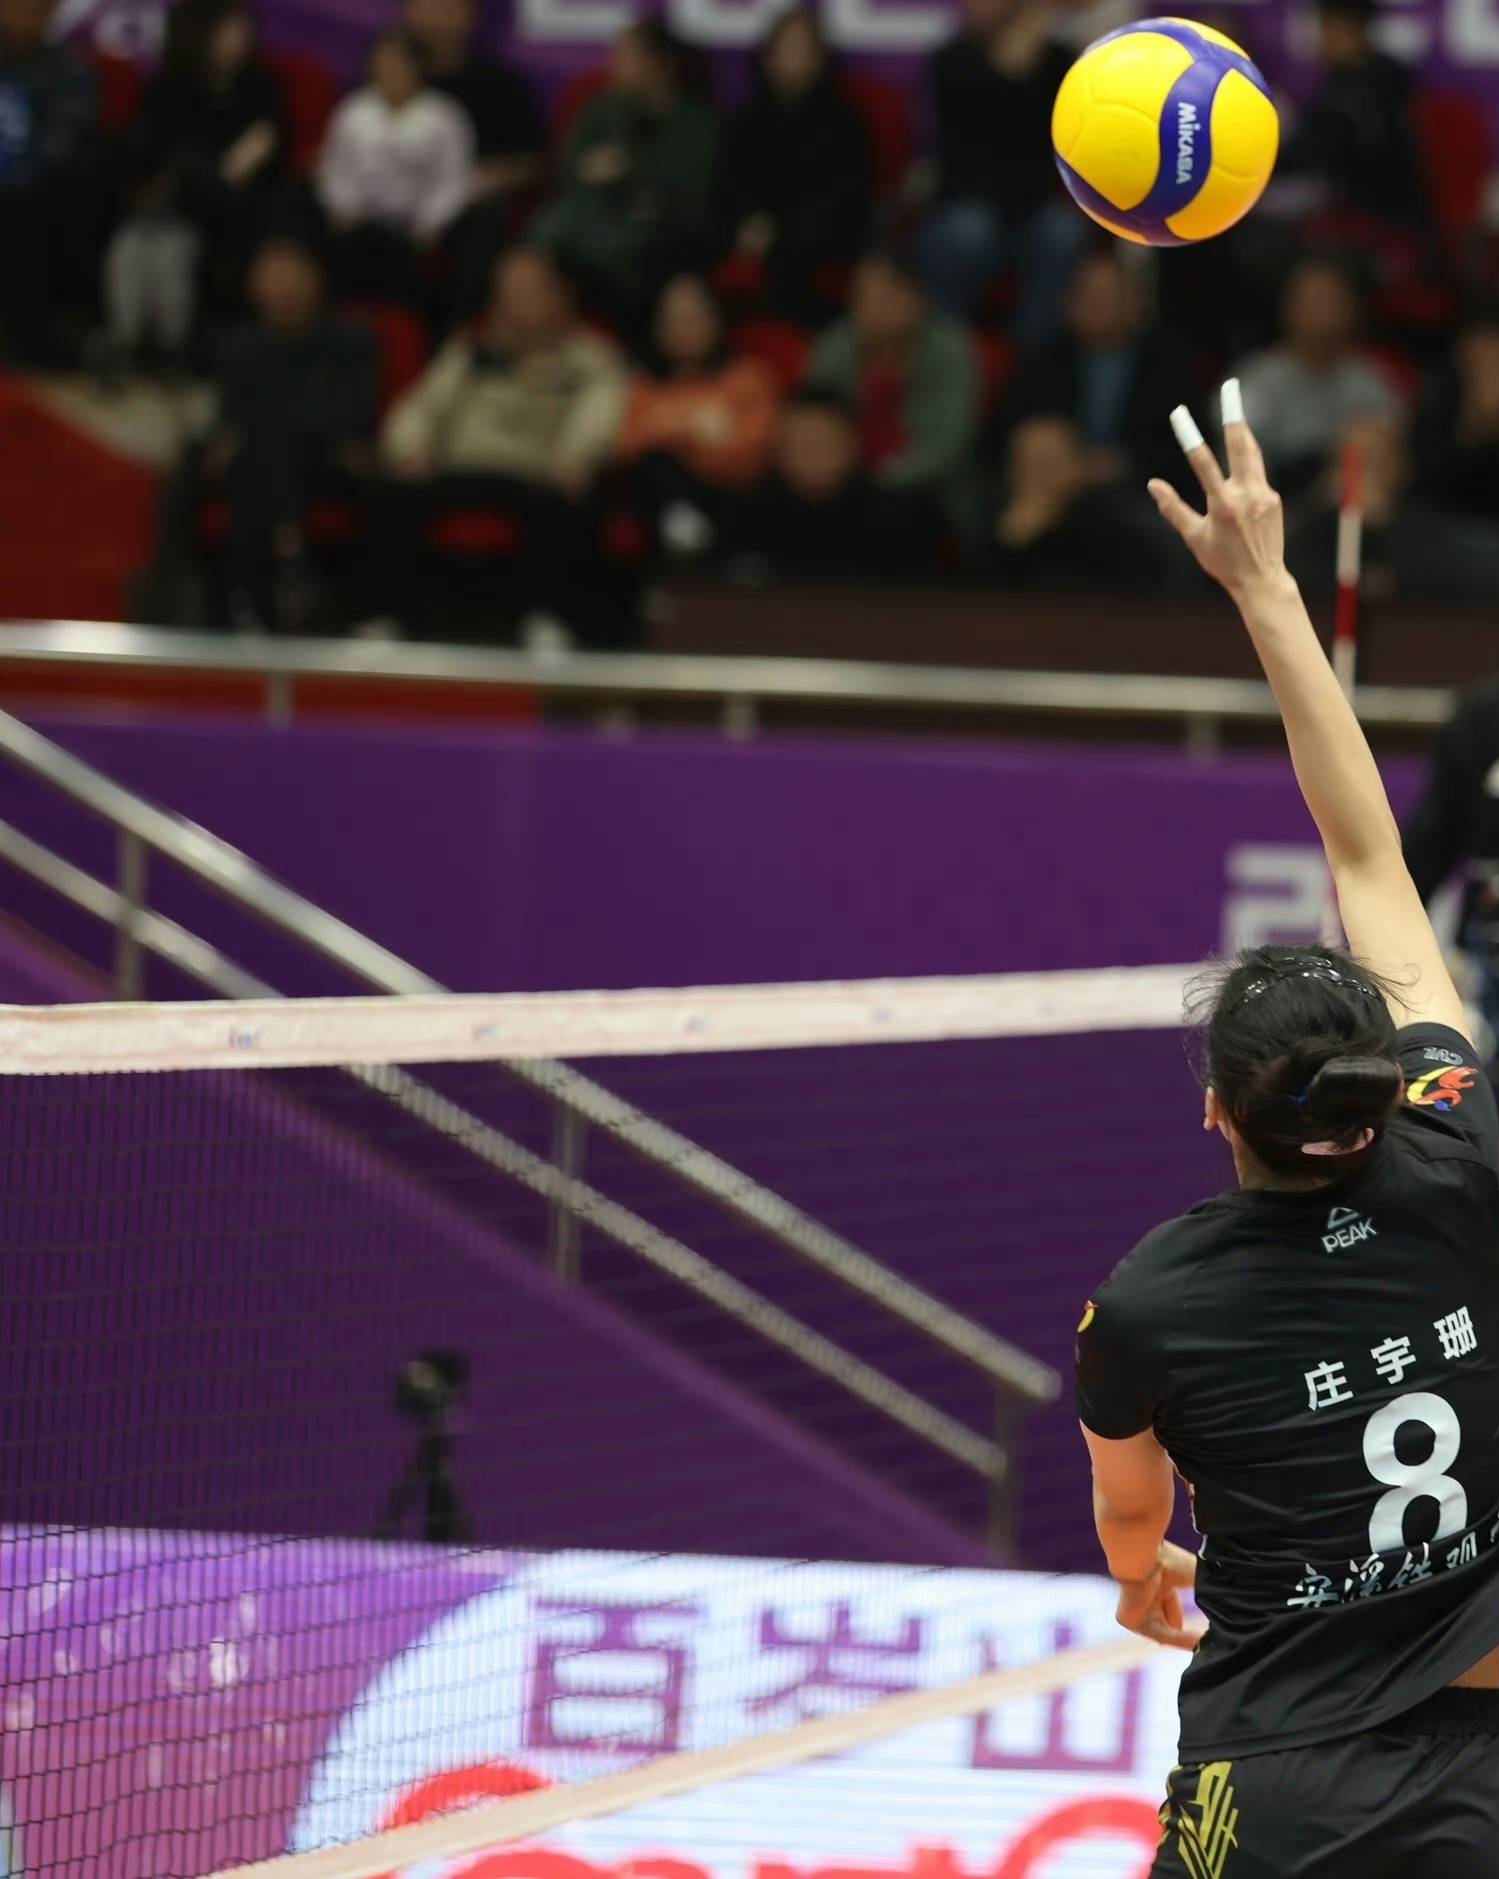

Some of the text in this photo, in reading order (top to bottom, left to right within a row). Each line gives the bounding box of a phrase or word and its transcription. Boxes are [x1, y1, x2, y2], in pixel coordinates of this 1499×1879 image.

[1321, 1217, 1377, 1253] PEAK
[1304, 1306, 1477, 1411] 庄宇珊
[1363, 1391, 1468, 1554] 8
